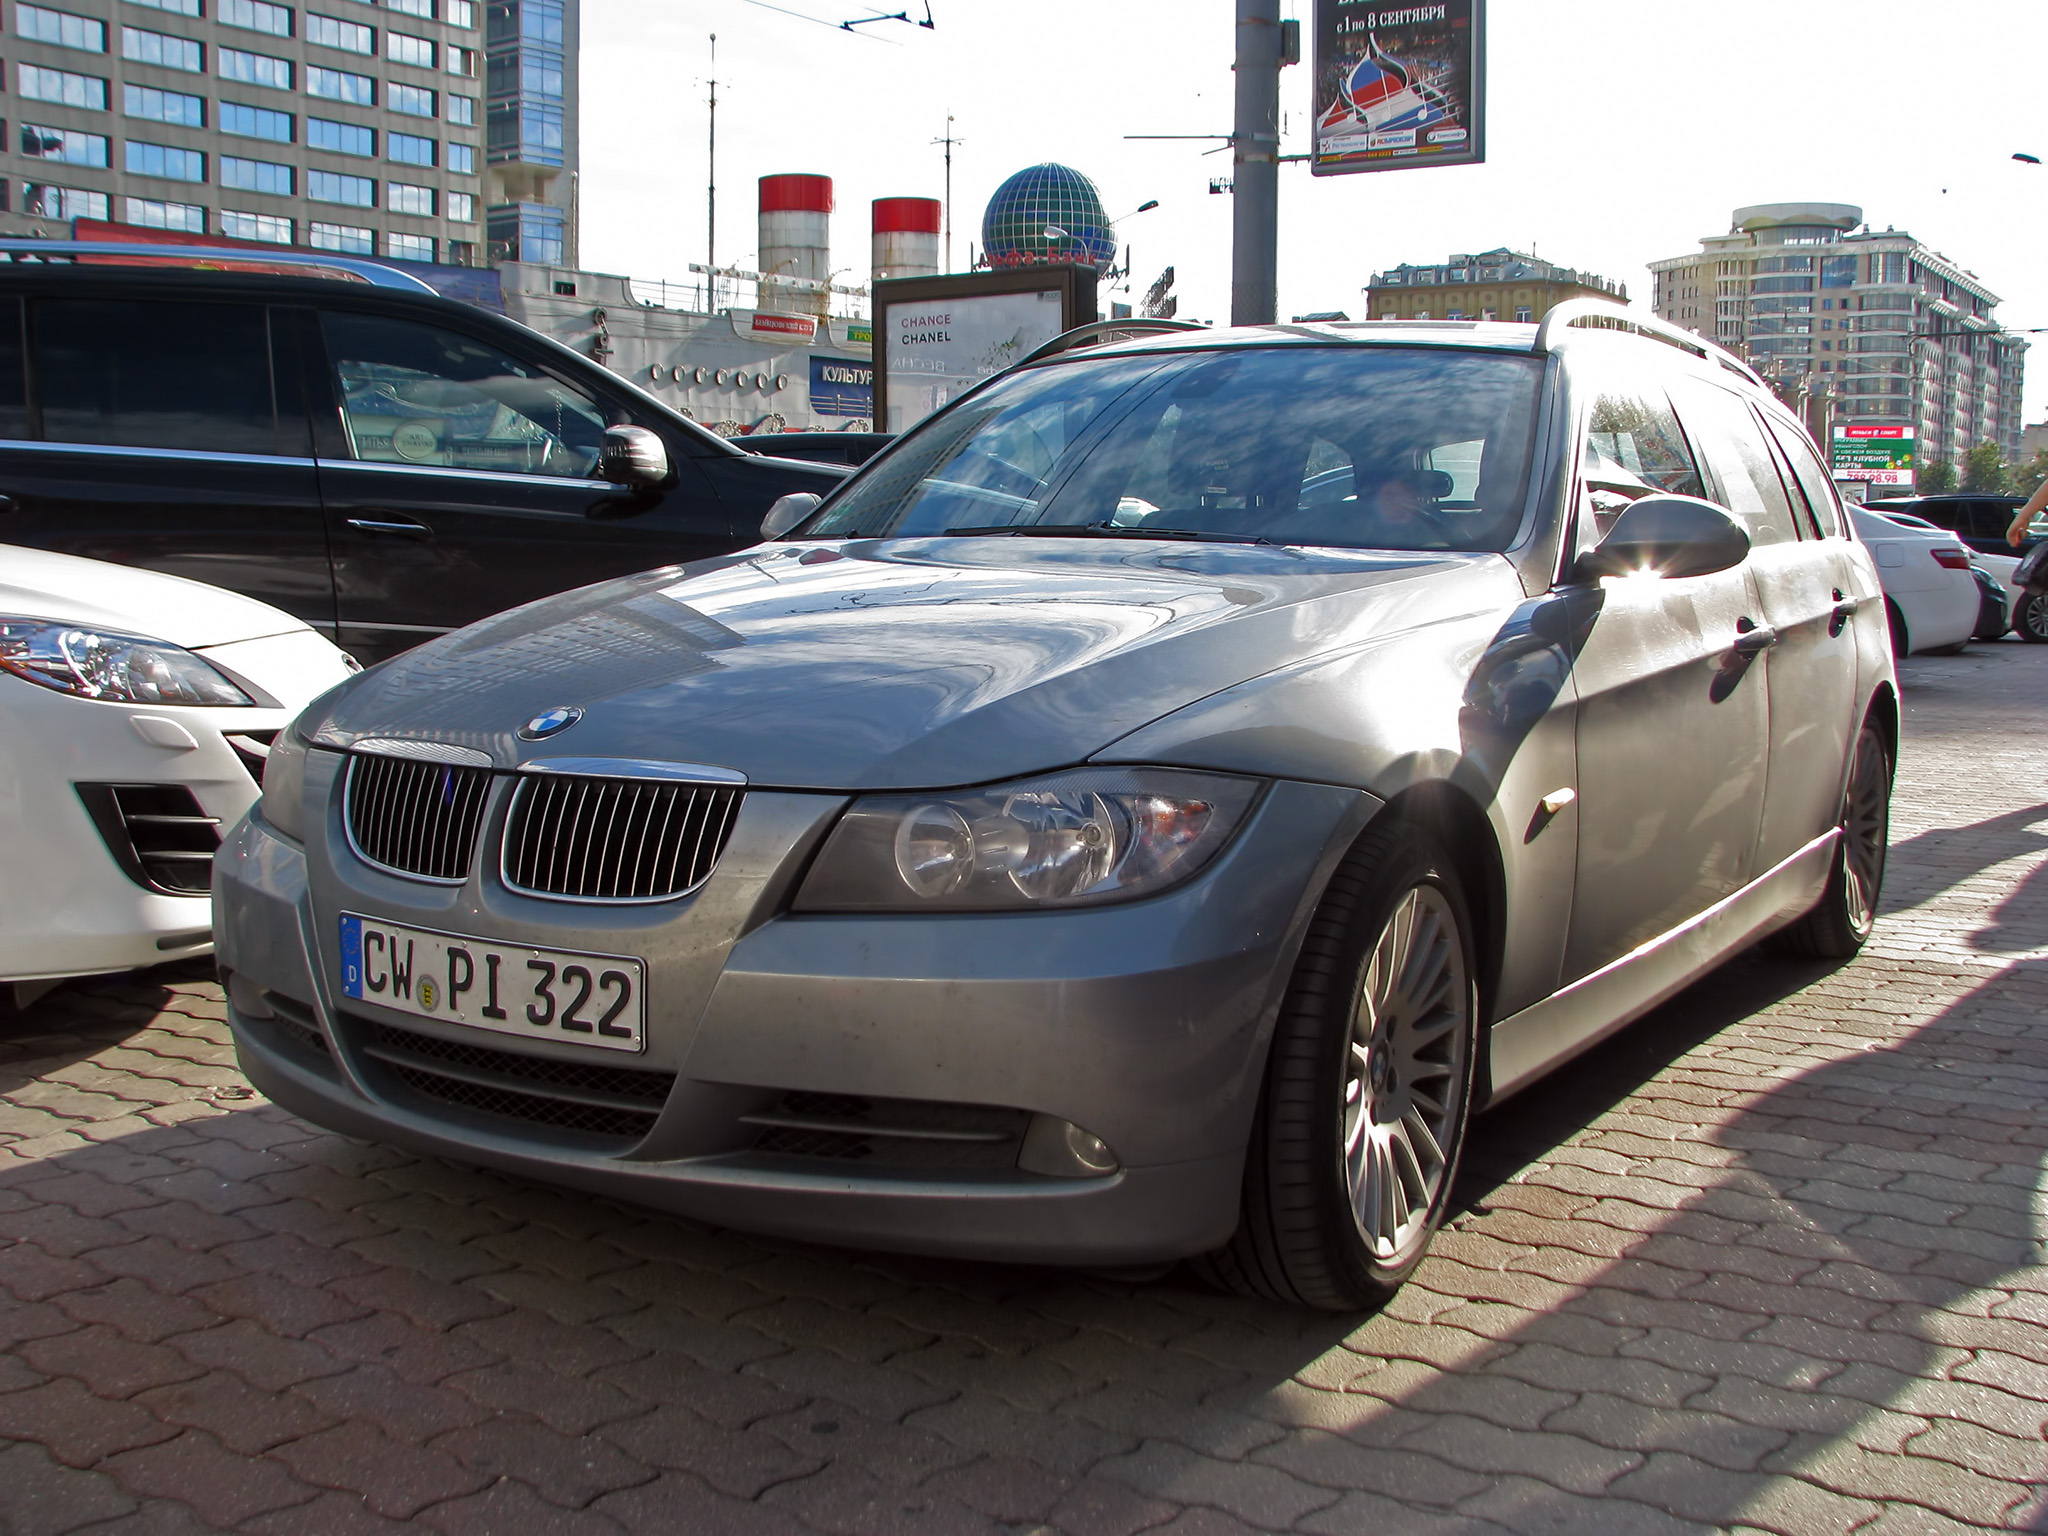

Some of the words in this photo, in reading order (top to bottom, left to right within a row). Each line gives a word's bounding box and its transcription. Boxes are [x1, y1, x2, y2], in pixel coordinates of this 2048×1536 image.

[1344, 15, 1350, 32] 1
[1352, 20, 1365, 31] по
[1367, 12, 1376, 29] 8
[1379, 4, 1447, 27] СЕНТЯБРЯ
[901, 314, 951, 328] CHANCE
[901, 332, 951, 345] CHANEL
[822, 365, 873, 385] КУЛЬТУР
[347, 965, 357, 983] D
[363, 930, 414, 1000] CW
[447, 946, 507, 1020] PI
[526, 959, 633, 1039] 322
